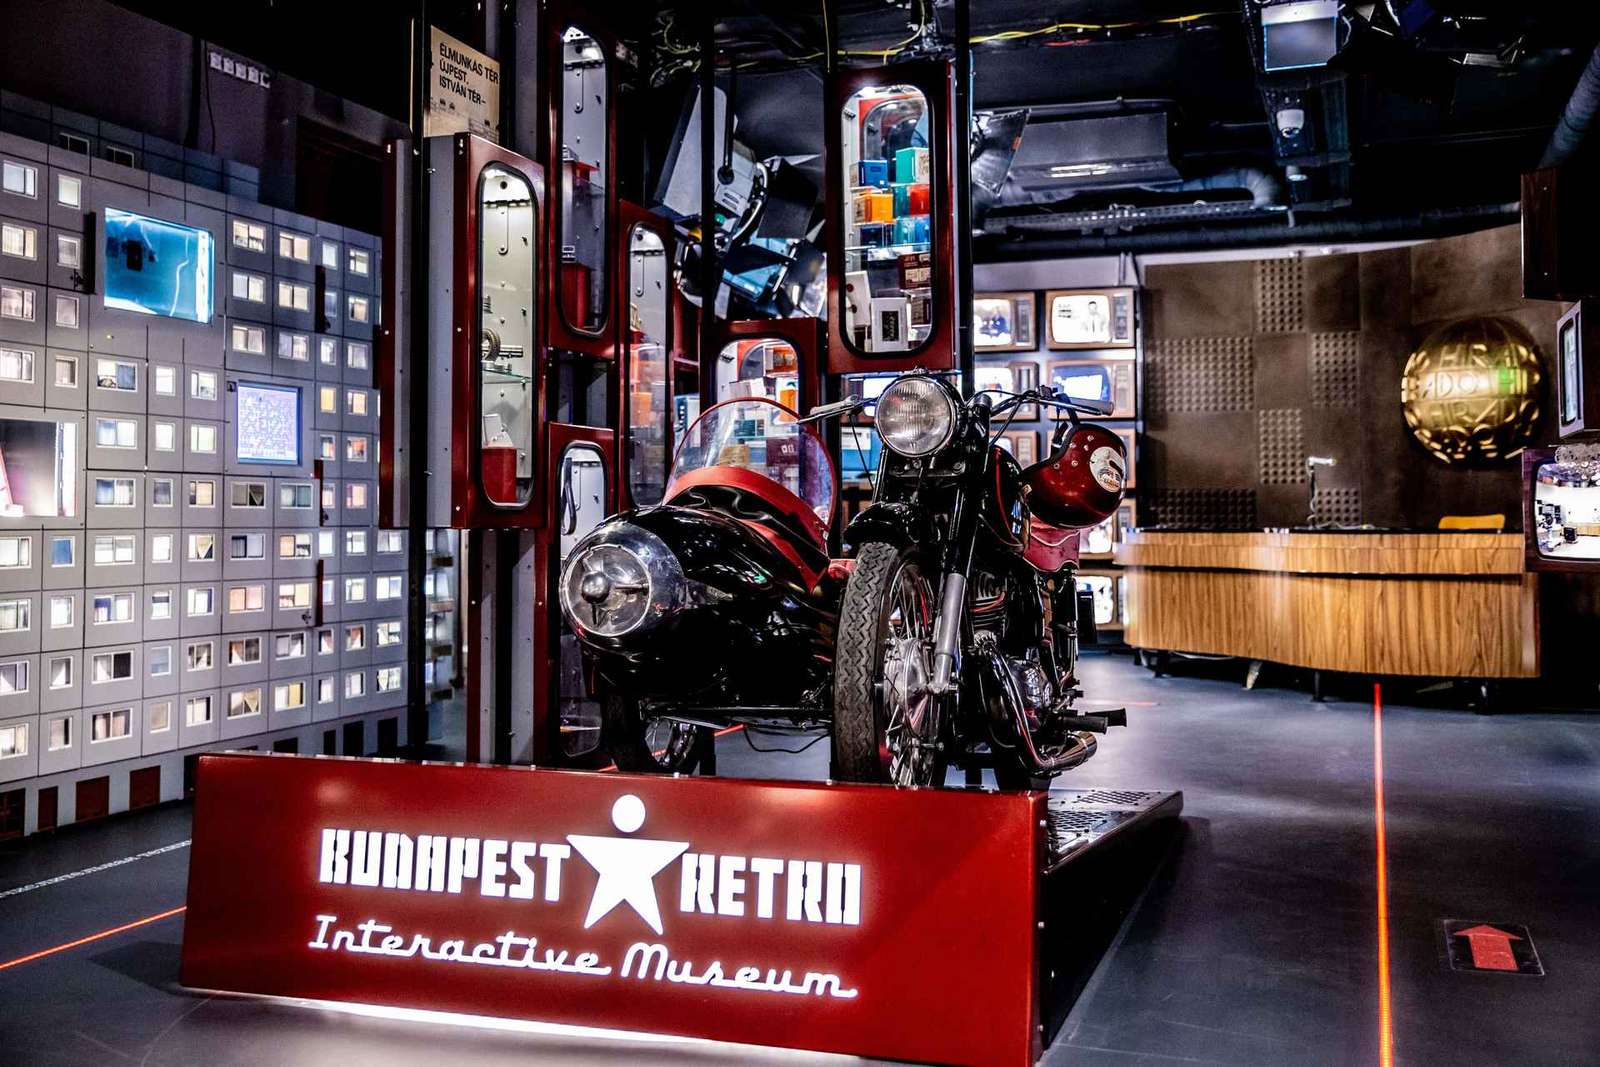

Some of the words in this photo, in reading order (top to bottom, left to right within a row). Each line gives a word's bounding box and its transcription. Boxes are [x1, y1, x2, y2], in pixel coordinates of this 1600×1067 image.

[318, 827, 572, 903] BUDAPEST
[679, 852, 862, 926] RETRO
[307, 914, 613, 977] Interactive
[619, 941, 860, 999] Museum
